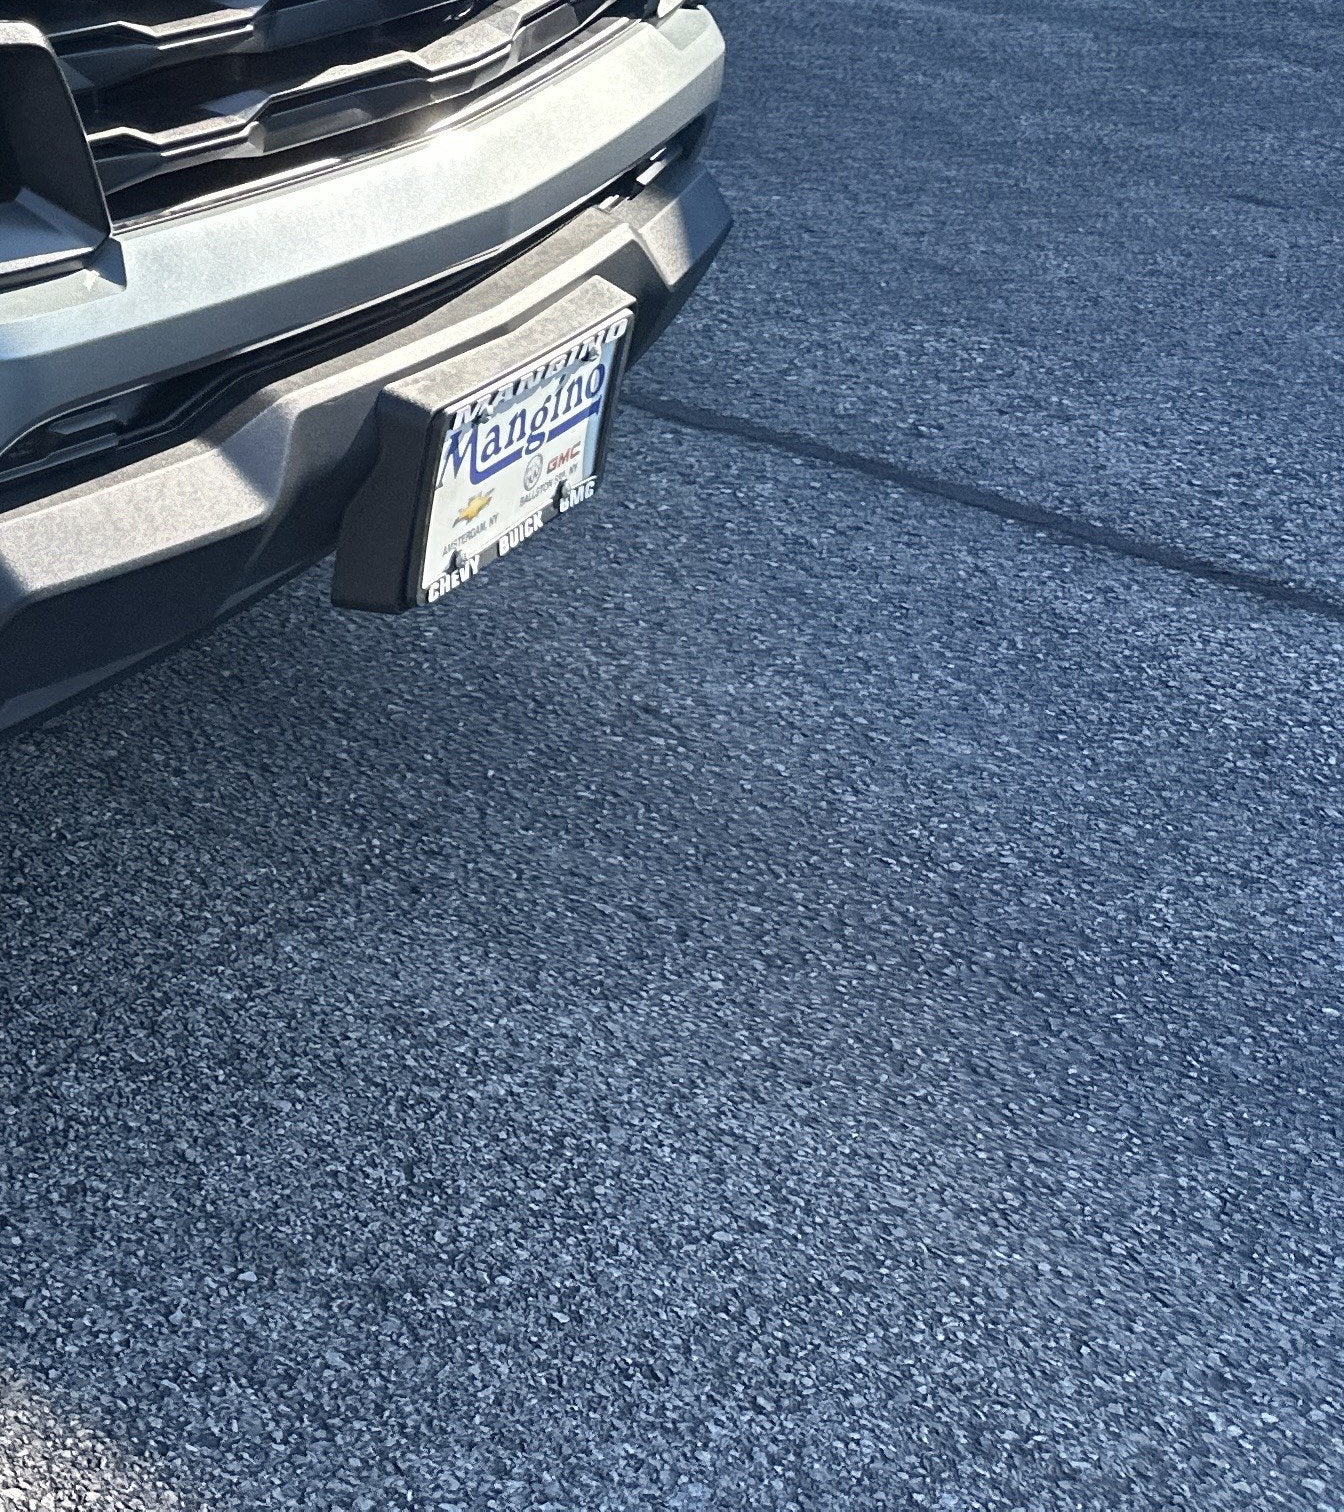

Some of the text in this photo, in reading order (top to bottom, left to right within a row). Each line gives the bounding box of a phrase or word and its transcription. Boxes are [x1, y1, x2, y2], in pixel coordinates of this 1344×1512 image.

[453, 318, 628, 430] MANGINO
[437, 364, 605, 488] Mangino
[547, 441, 581, 474] GMC
[428, 554, 480, 603] CHEVY
[499, 510, 543, 556] BUICK
